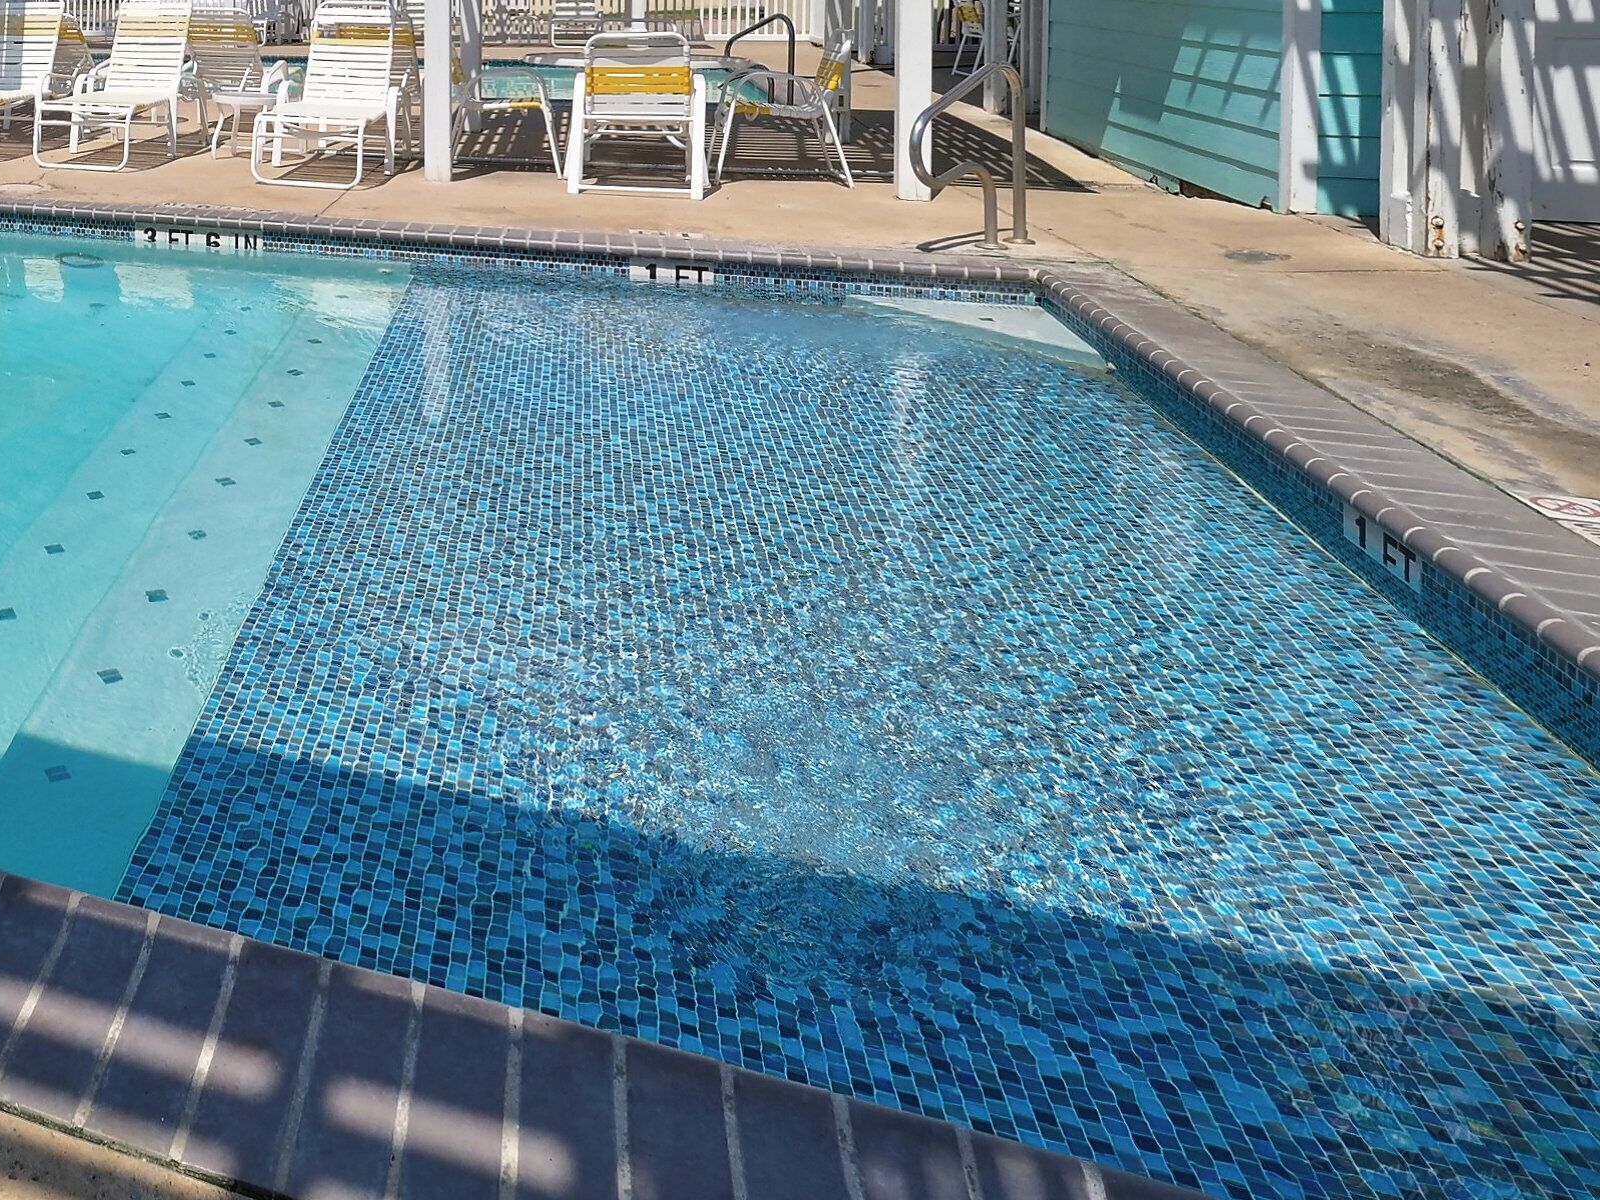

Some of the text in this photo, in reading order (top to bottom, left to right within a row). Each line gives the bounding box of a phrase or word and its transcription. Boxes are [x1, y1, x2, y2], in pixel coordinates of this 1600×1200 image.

[143, 227, 258, 251] 3 FT 6 IN
[645, 263, 709, 283] 1 FT
[1355, 514, 1417, 583] 1 FT
